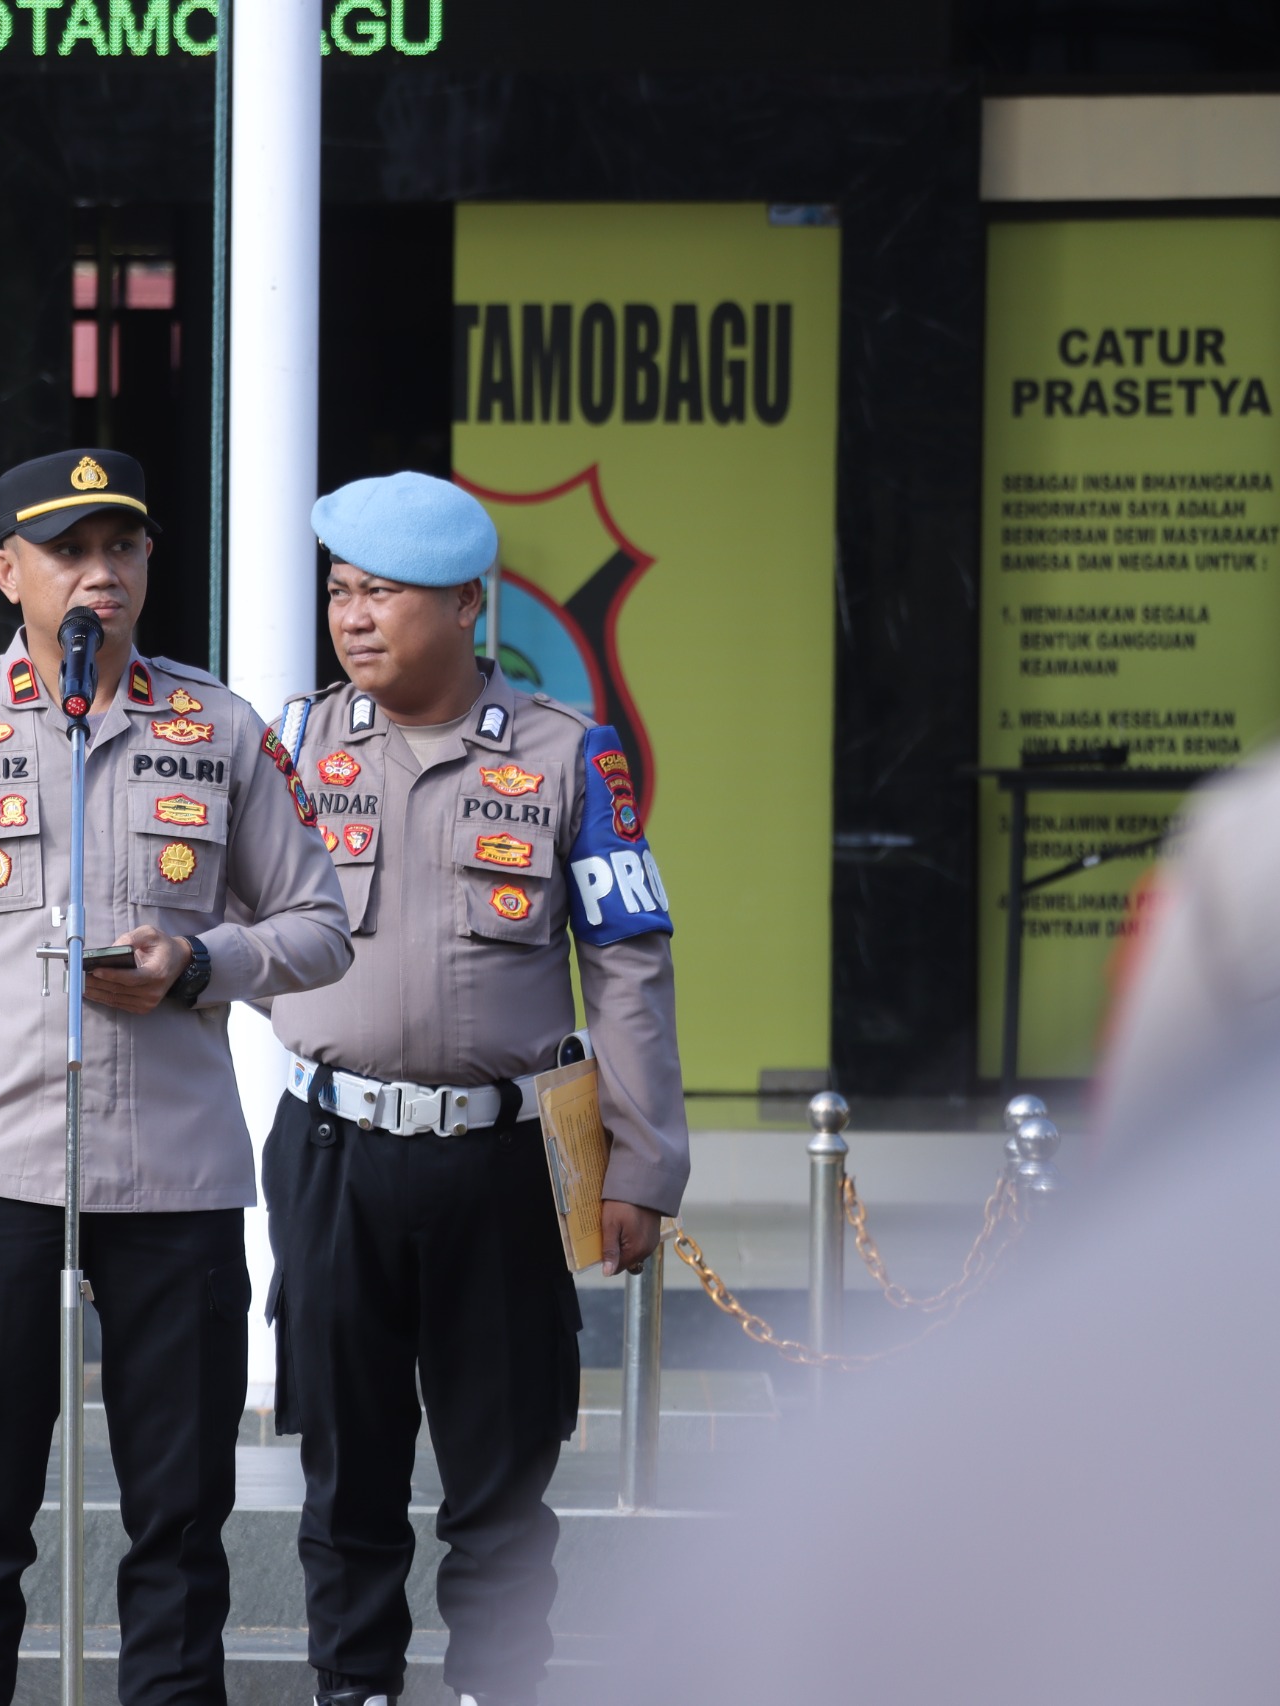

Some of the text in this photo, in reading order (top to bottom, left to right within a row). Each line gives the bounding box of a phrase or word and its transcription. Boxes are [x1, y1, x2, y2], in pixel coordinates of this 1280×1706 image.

[1058, 327, 1226, 367] CATUR
[1012, 377, 1273, 418] PRASETYA
[1002, 475, 1273, 493] SEBAGAI INSAN BHAYANGKARA
[1001, 501, 1246, 519] KEHORMATAN SAYA ADALAH
[1001, 527, 1108, 545] BERKORBAN
[1113, 527, 1157, 545] DEMI
[1000, 553, 1072, 572] BANGSA
[1077, 553, 1113, 572] DAN
[1118, 553, 1190, 572] NEGARA
[1020, 605, 1136, 624] MENIADAKAN
[1142, 605, 1210, 624] SEGALA
[1019, 631, 1196, 650] BENTUK GANGGUAN
[1019, 657, 1118, 676] KEAMANAN
[1019, 710, 1102, 729] MENJAGA
[1108, 710, 1236, 729] KESELAMATAN
[1184, 737, 1241, 754] BENDA
[133, 754, 224, 784] POLRI
[462, 798, 551, 828] POLRI
